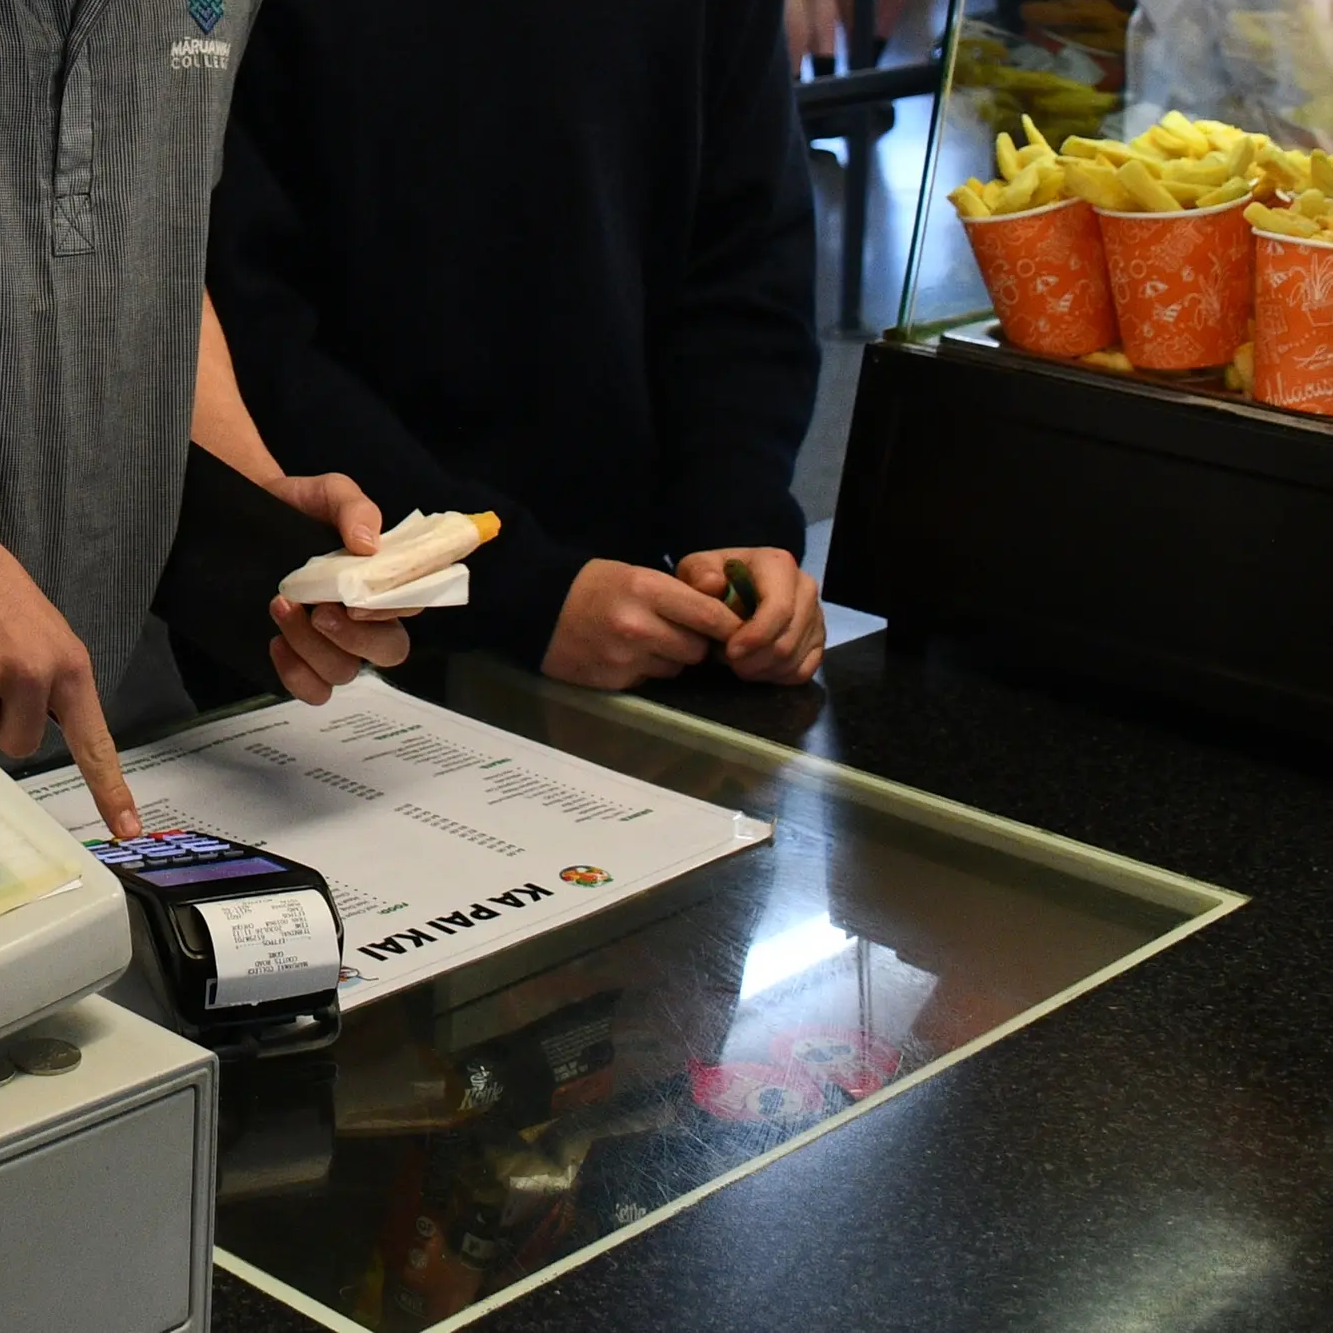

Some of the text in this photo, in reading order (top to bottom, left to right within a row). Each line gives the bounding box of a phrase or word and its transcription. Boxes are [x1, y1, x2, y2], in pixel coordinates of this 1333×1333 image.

[356, 883, 555, 961] KA PAI KAI
